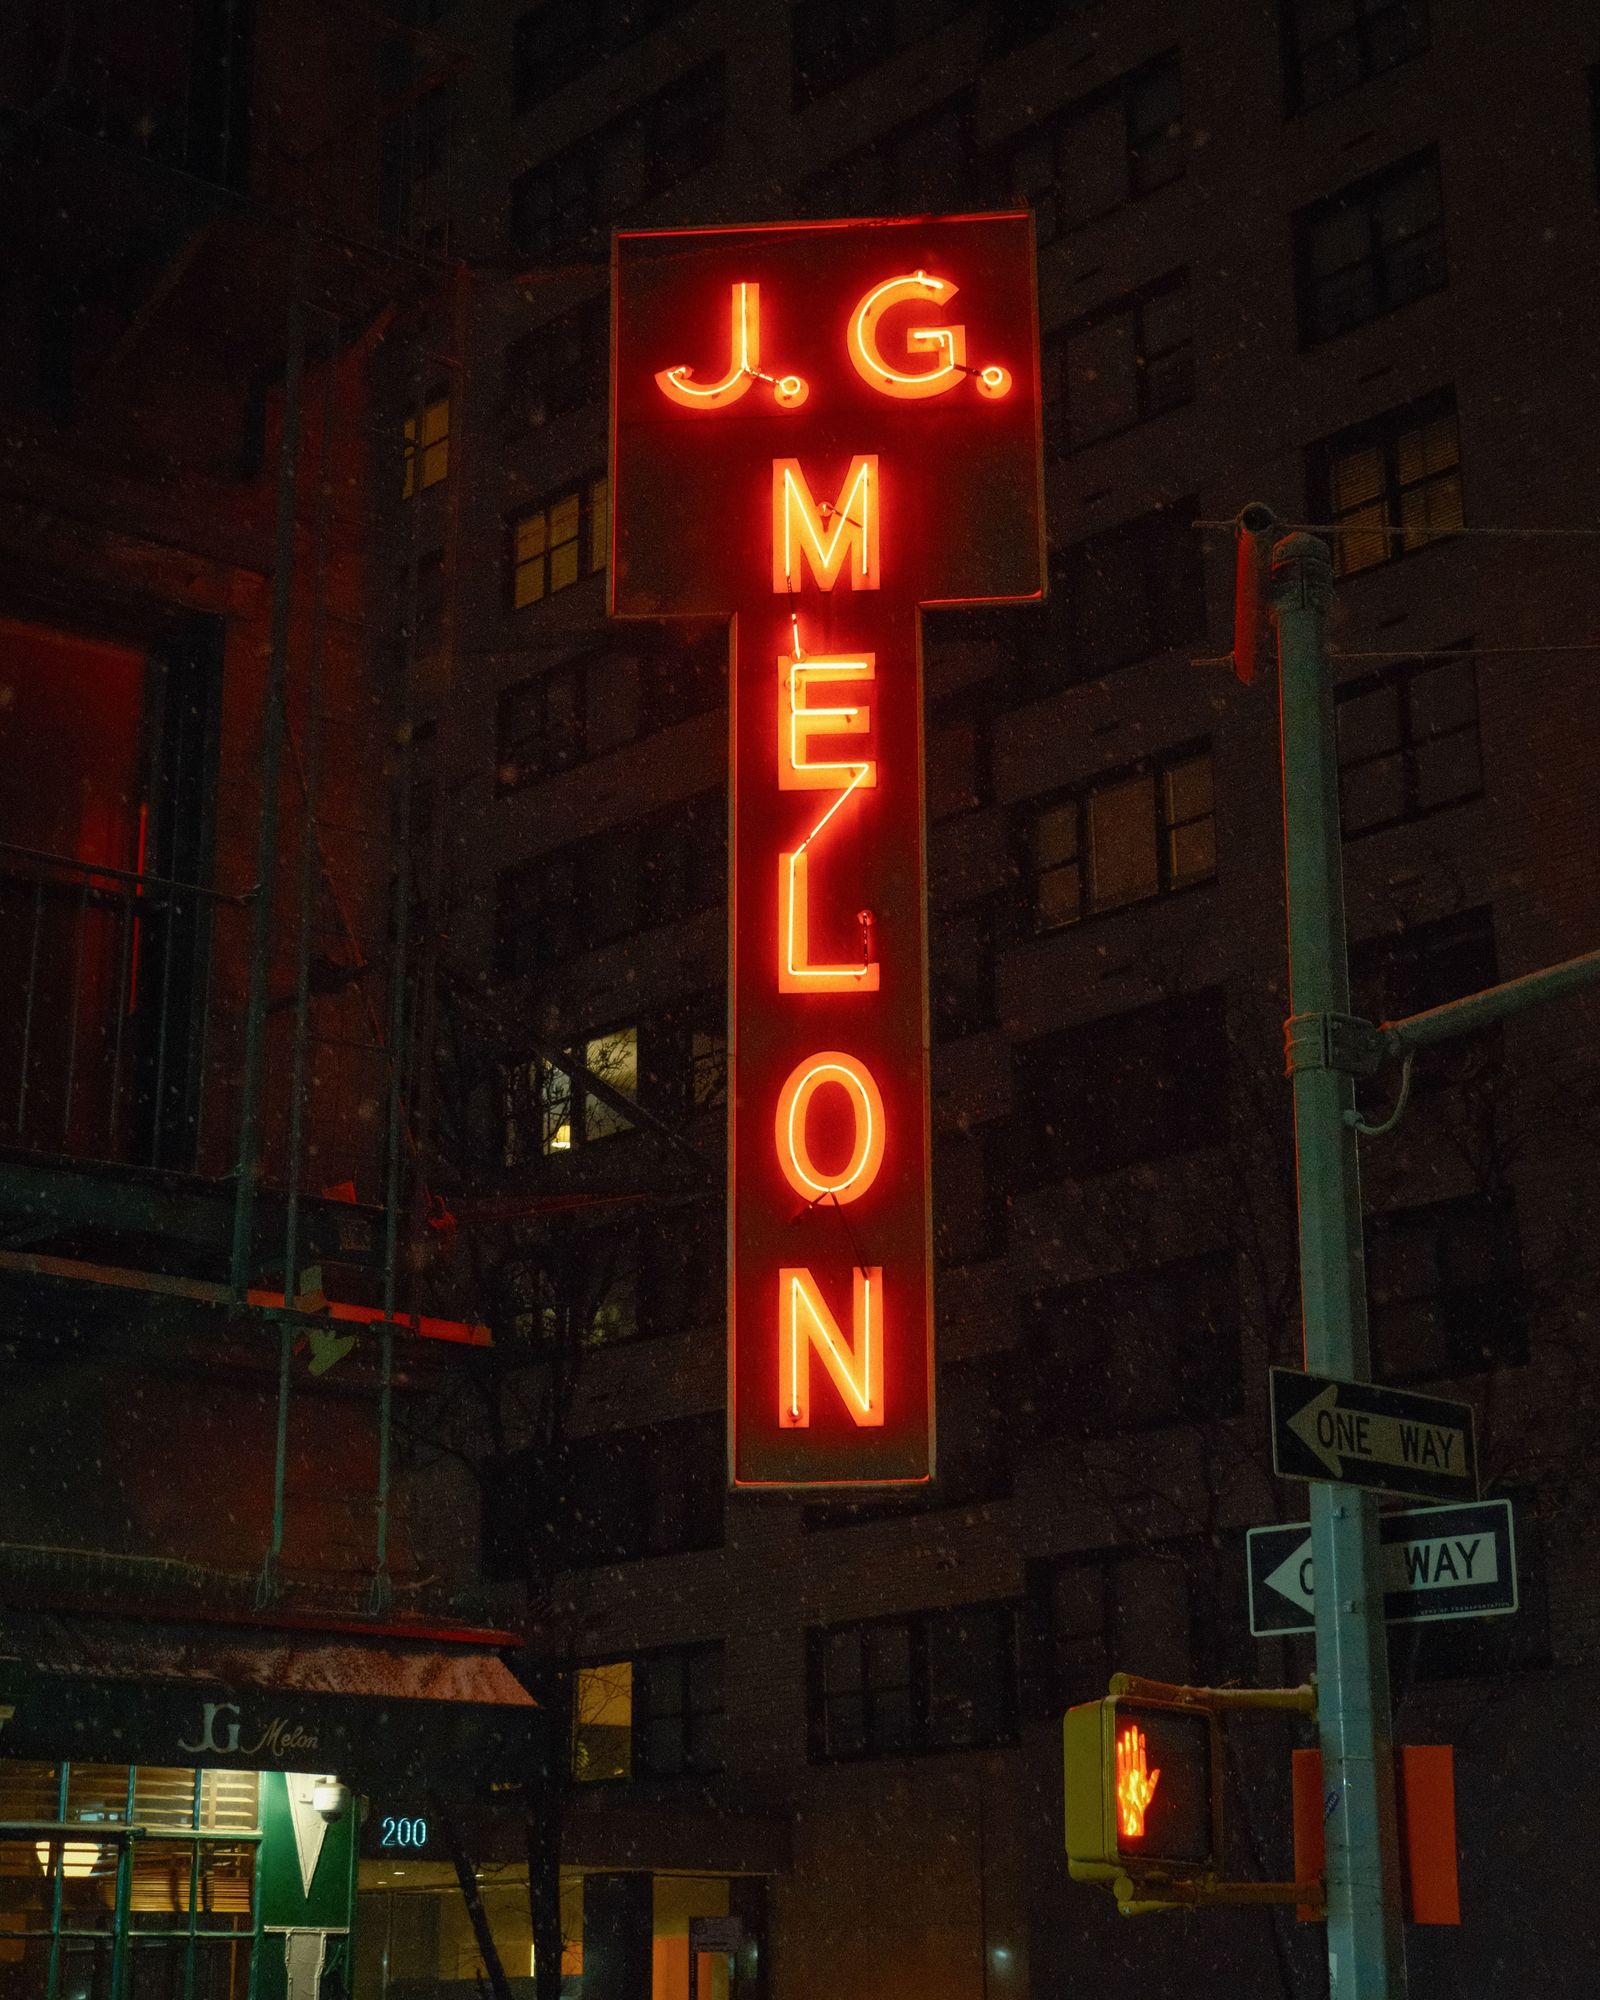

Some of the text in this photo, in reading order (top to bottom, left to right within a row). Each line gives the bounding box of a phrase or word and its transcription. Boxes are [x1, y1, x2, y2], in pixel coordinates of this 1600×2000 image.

[772, 454, 887, 1429] MELON
[1316, 1409, 1455, 1470] ONE WAY
[1404, 1539, 1481, 1586] WAY
[241, 1717, 319, 1757] Melon
[380, 1815, 428, 1847] 200
